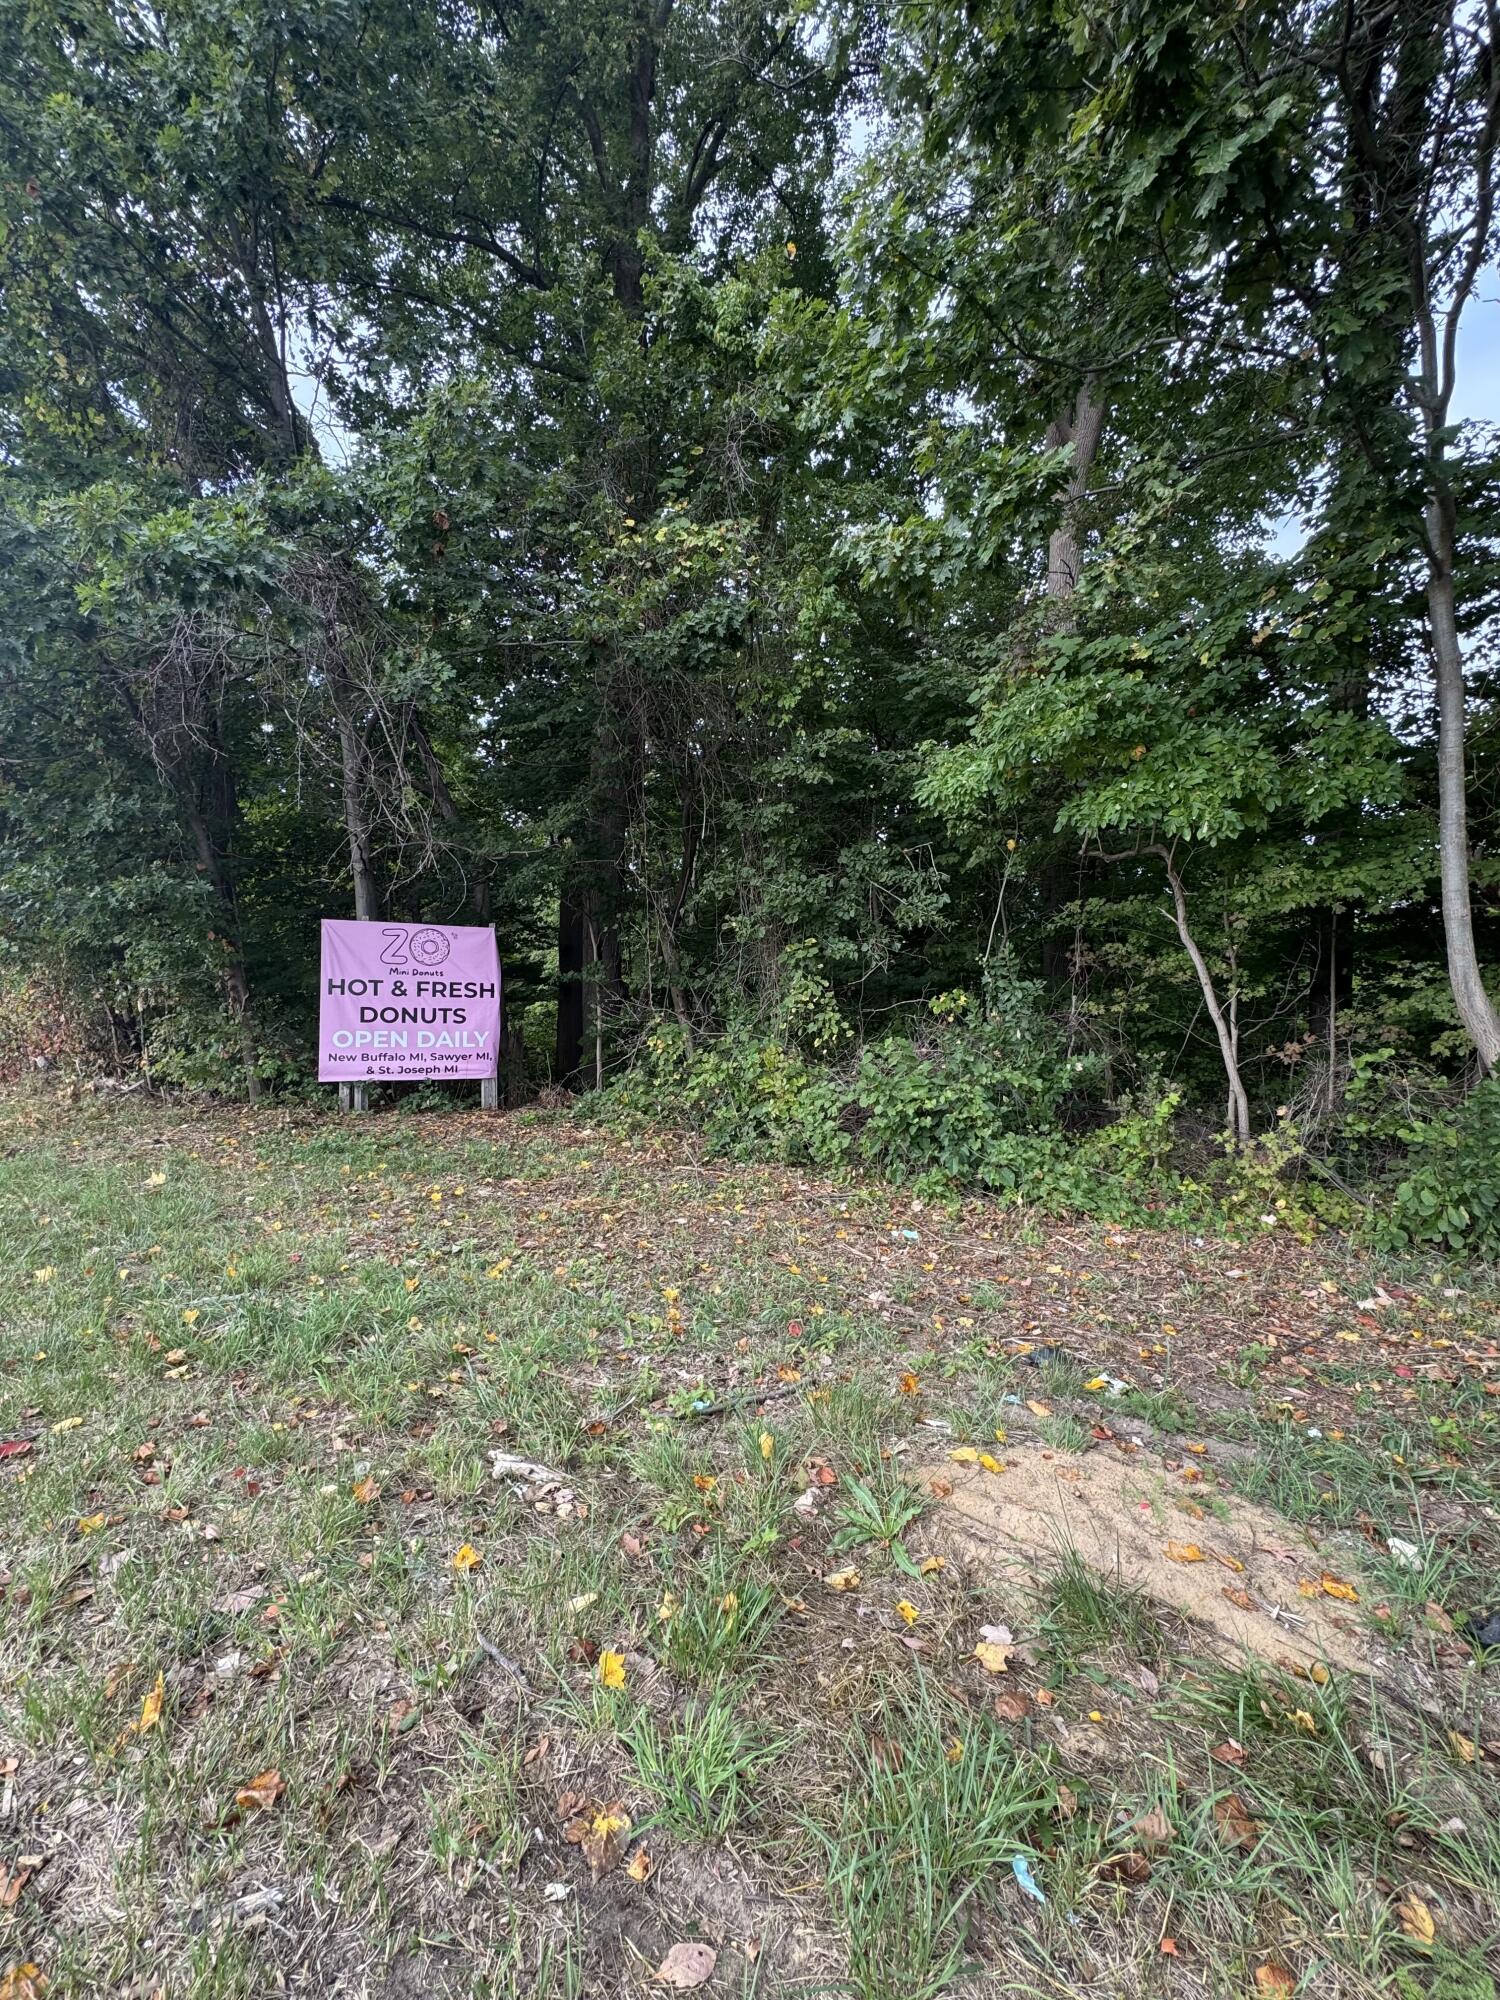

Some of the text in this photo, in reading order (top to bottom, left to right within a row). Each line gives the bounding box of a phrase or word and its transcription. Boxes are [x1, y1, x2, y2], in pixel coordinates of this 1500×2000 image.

[389, 967, 444, 977] Mini Donuts
[328, 978, 496, 999] HOT & FRESH
[360, 1006, 467, 1024] DONUTS
[332, 1030, 489, 1048] OPEN DAILY
[328, 1052, 493, 1063] New Buffalo MI, Sawyer MI,
[366, 1065, 458, 1076] & St. Joseph MI
